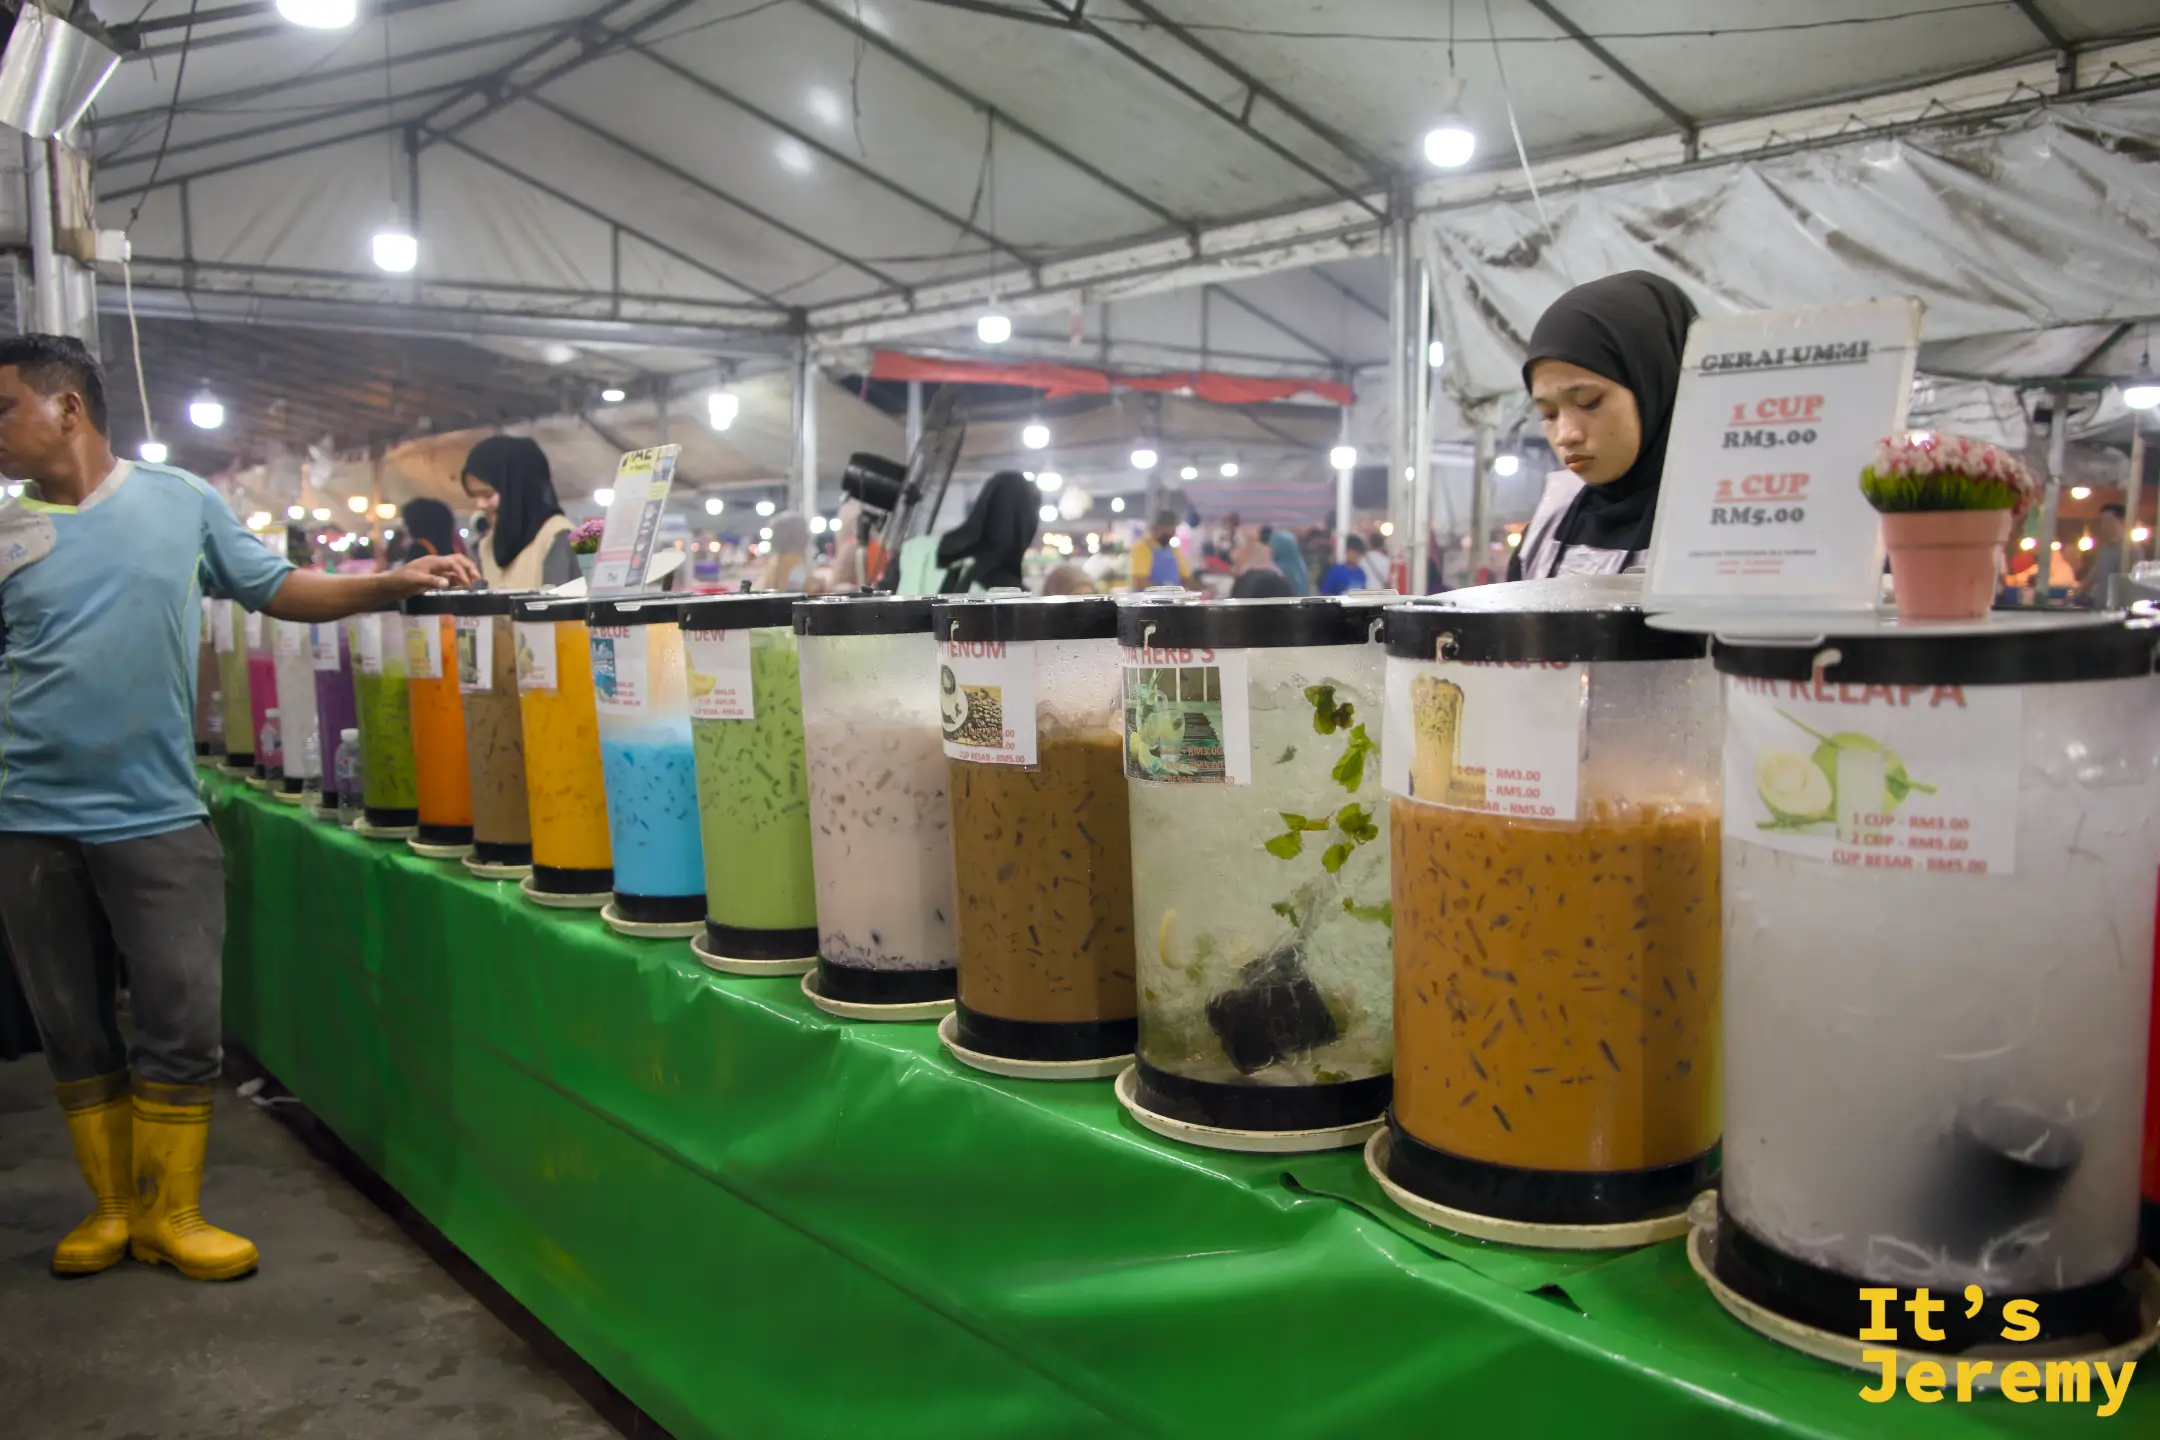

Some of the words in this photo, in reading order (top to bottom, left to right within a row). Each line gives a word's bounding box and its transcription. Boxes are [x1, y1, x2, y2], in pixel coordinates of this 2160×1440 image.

[1701, 347, 1786, 372] GERAI
[1793, 340, 1870, 364] UMMI
[1732, 403, 1746, 421] 1
[1756, 394, 1824, 419] CUP
[1722, 428, 1818, 449] RM3.00
[1715, 478, 1733, 498] 2
[1741, 472, 1810, 496] CUP
[1710, 506, 1805, 526] RM5.00
[694, 629, 726, 641] DEW
[1142, 647, 1216, 665] HERBS
[1496, 768, 1541, 782] RM3.00
[1496, 784, 1541, 799] RM5.00
[1509, 803, 1555, 817] RM5.00
[1863, 812, 1896, 829] CUP
[1863, 833, 1895, 848] CUP
[1832, 849, 1862, 866] CUP
[1863, 852, 1914, 869] BESAR
